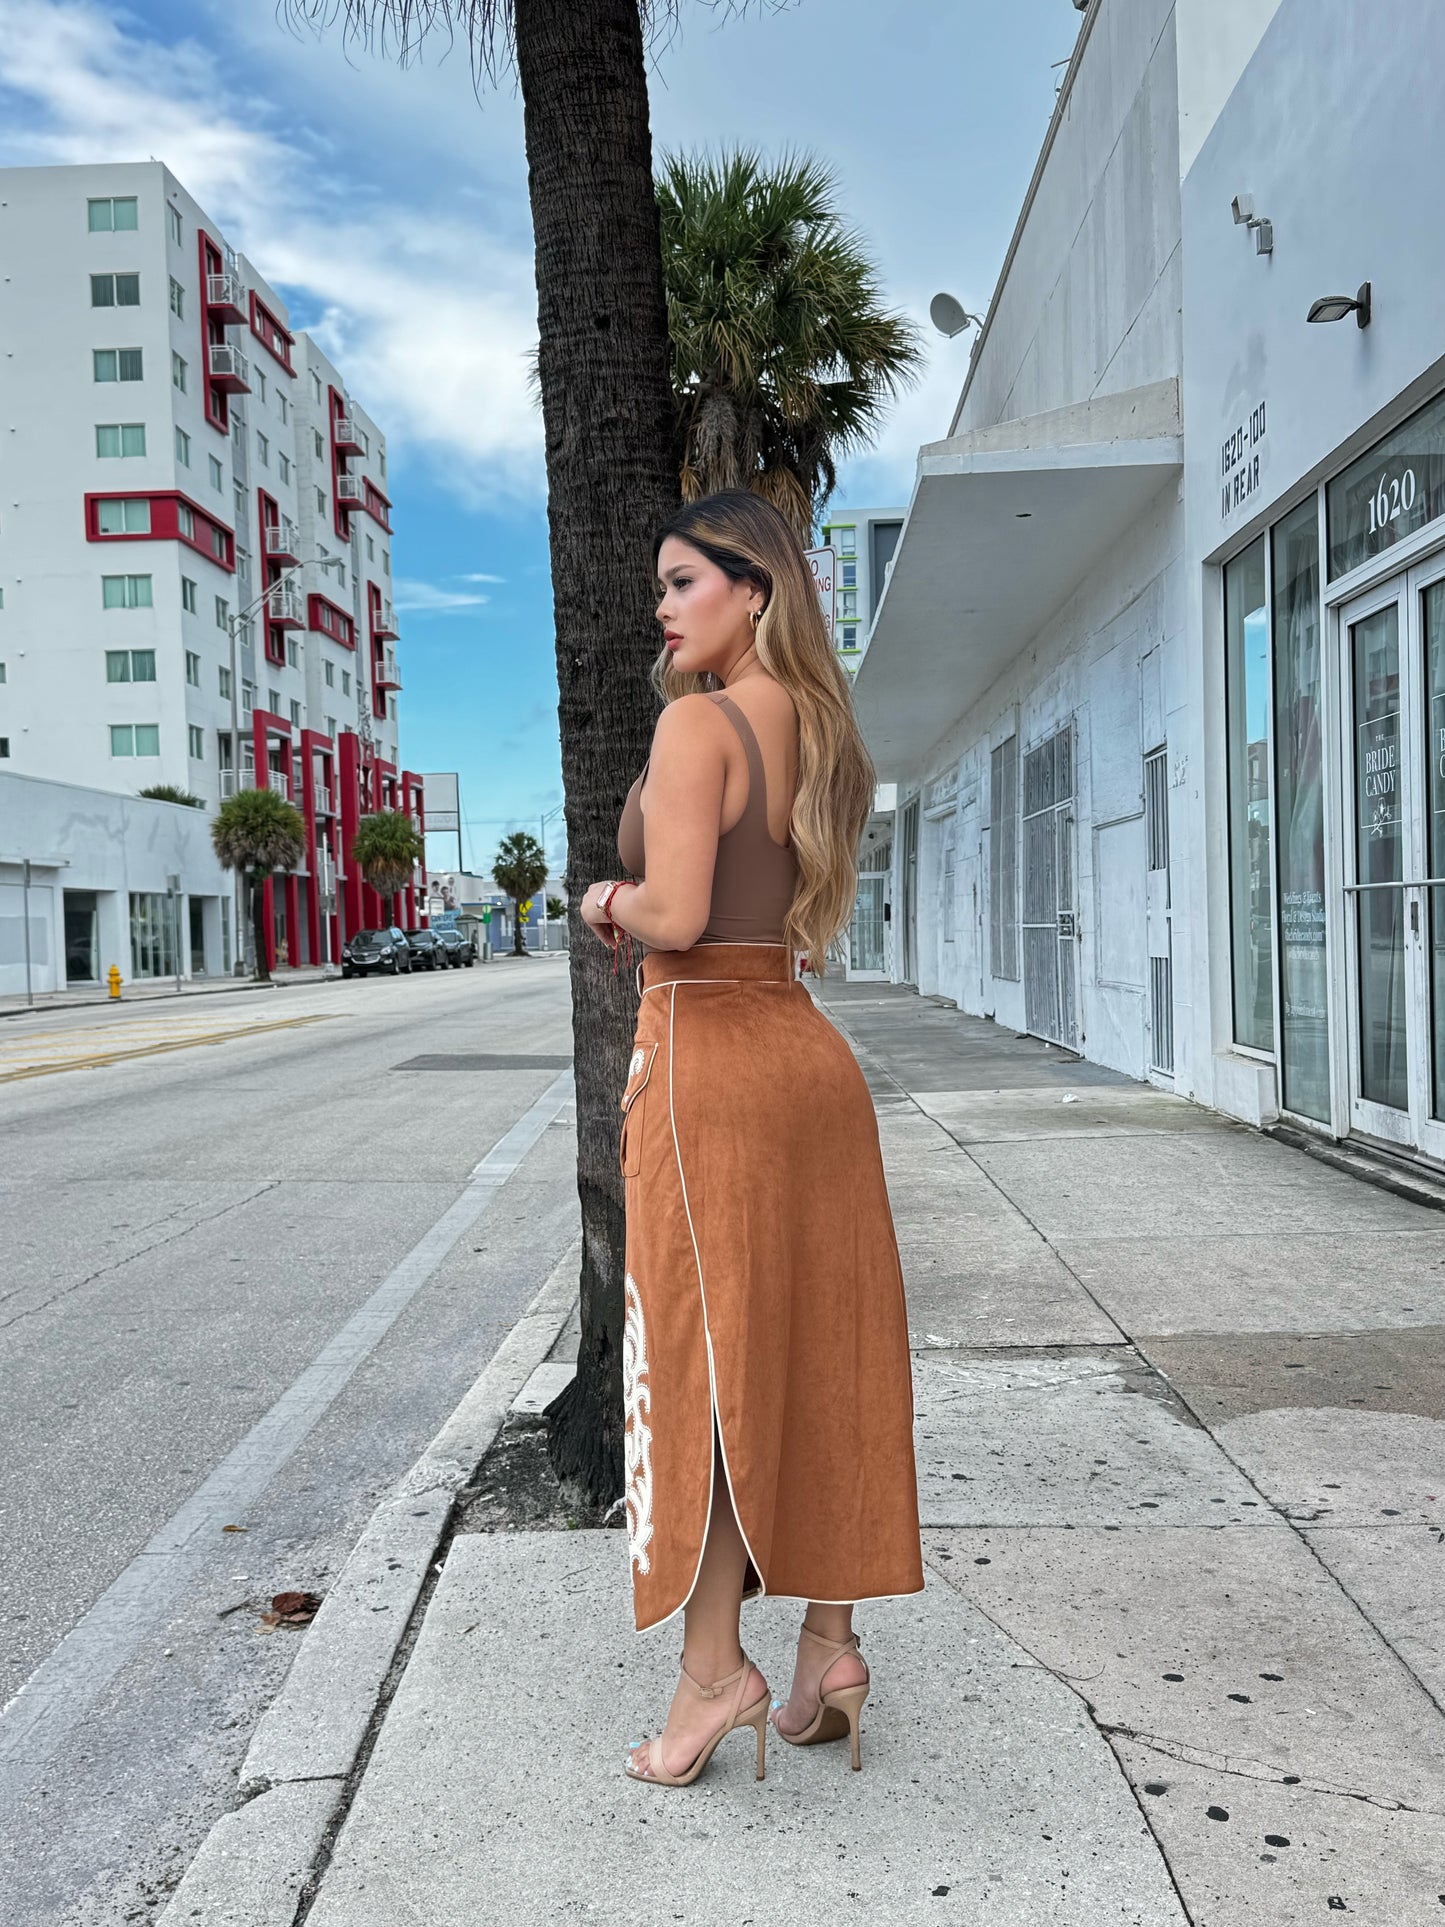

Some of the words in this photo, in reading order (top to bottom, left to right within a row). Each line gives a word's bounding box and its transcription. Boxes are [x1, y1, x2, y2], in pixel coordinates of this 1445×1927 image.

[1222, 400, 1266, 477] 1620-100
[1222, 482, 1231, 520] IN
[1233, 454, 1259, 509] REAR
[1368, 468, 1416, 535] 1620
[1365, 745, 1396, 774] BRIDE
[1365, 769, 1396, 797] CANDY
